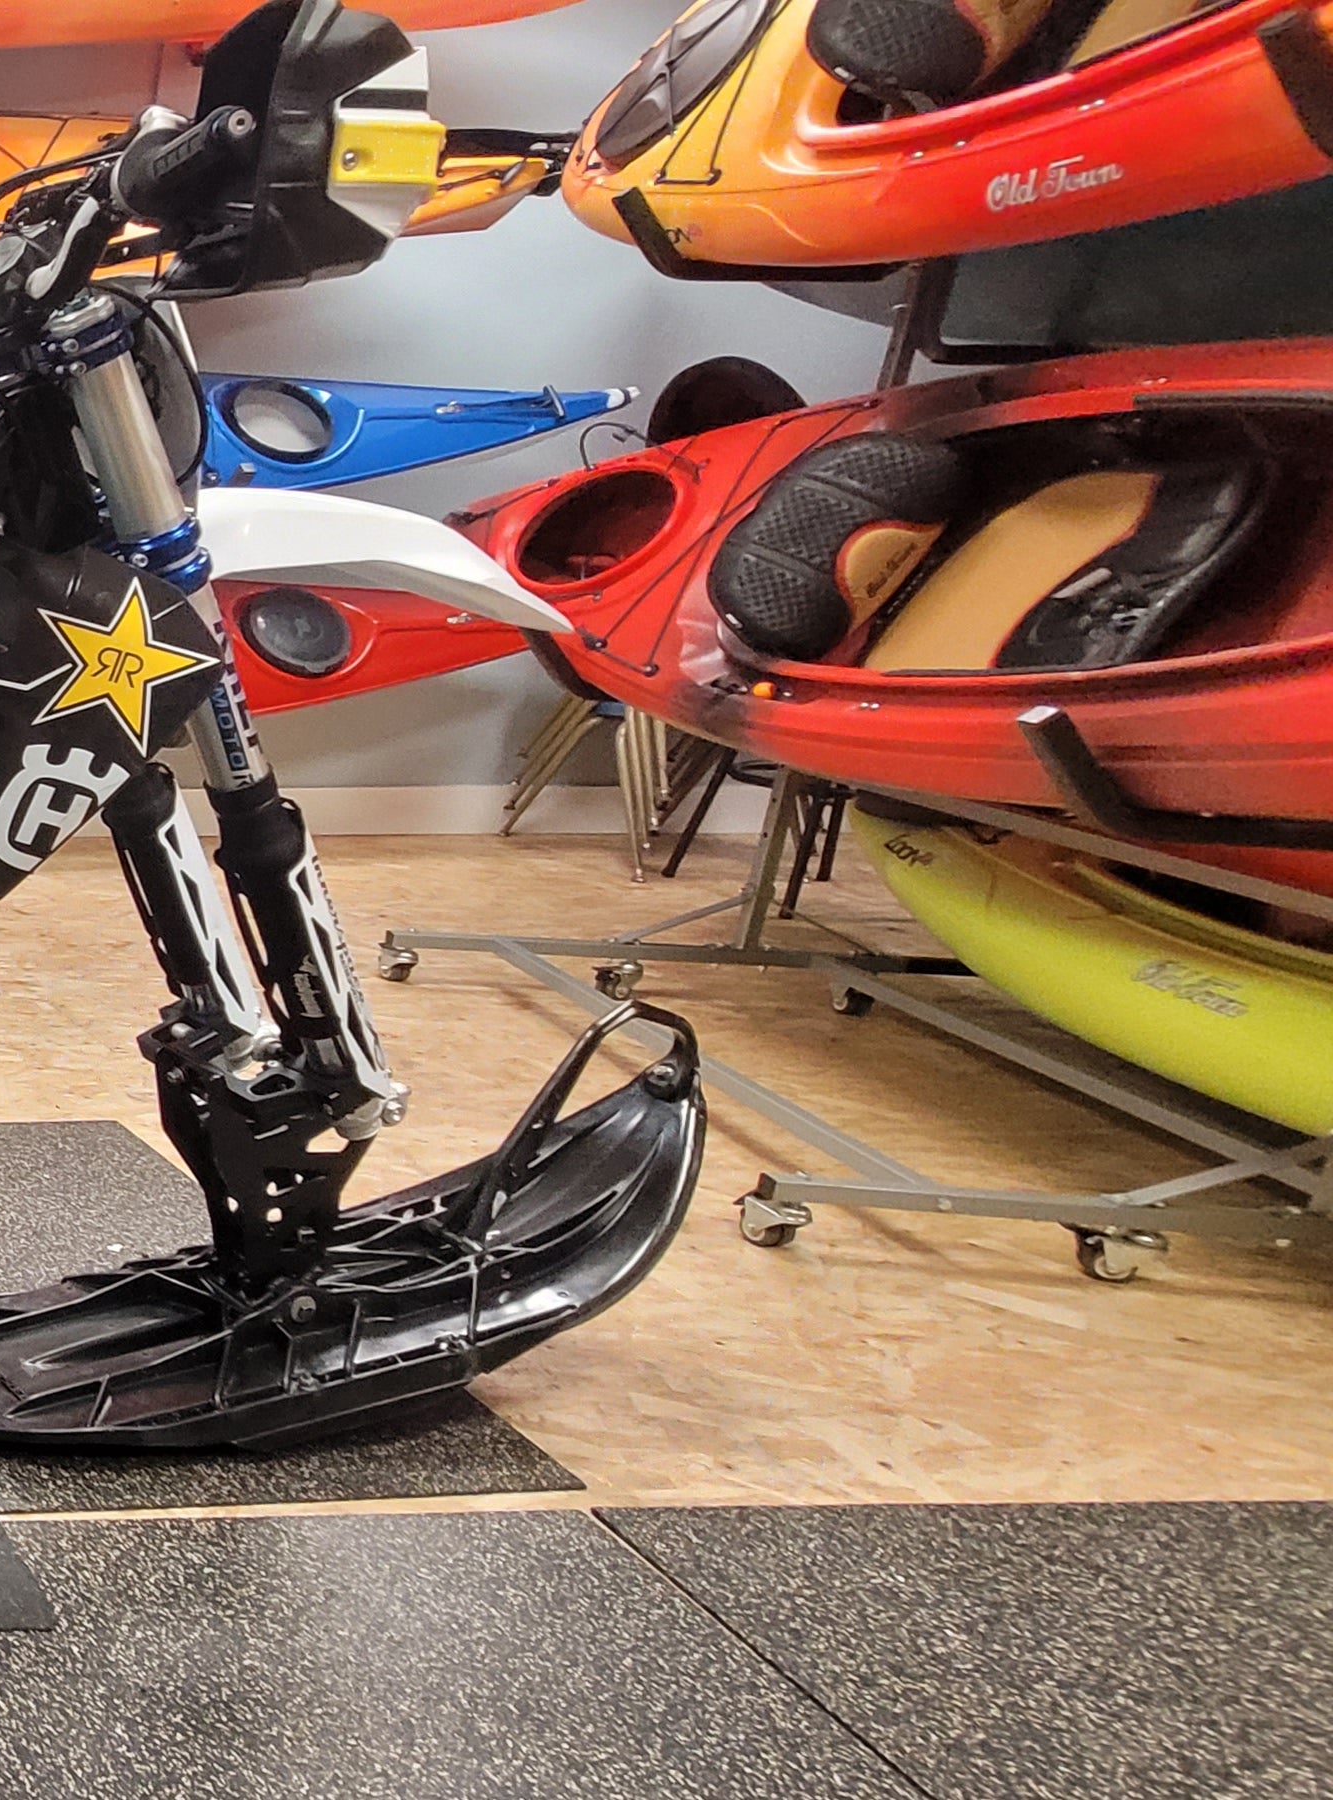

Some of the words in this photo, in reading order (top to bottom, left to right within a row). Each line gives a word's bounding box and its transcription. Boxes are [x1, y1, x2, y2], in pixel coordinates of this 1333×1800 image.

[986, 168, 1038, 212] Old
[1040, 154, 1124, 199] Town
[211, 681, 249, 773] MOTO
